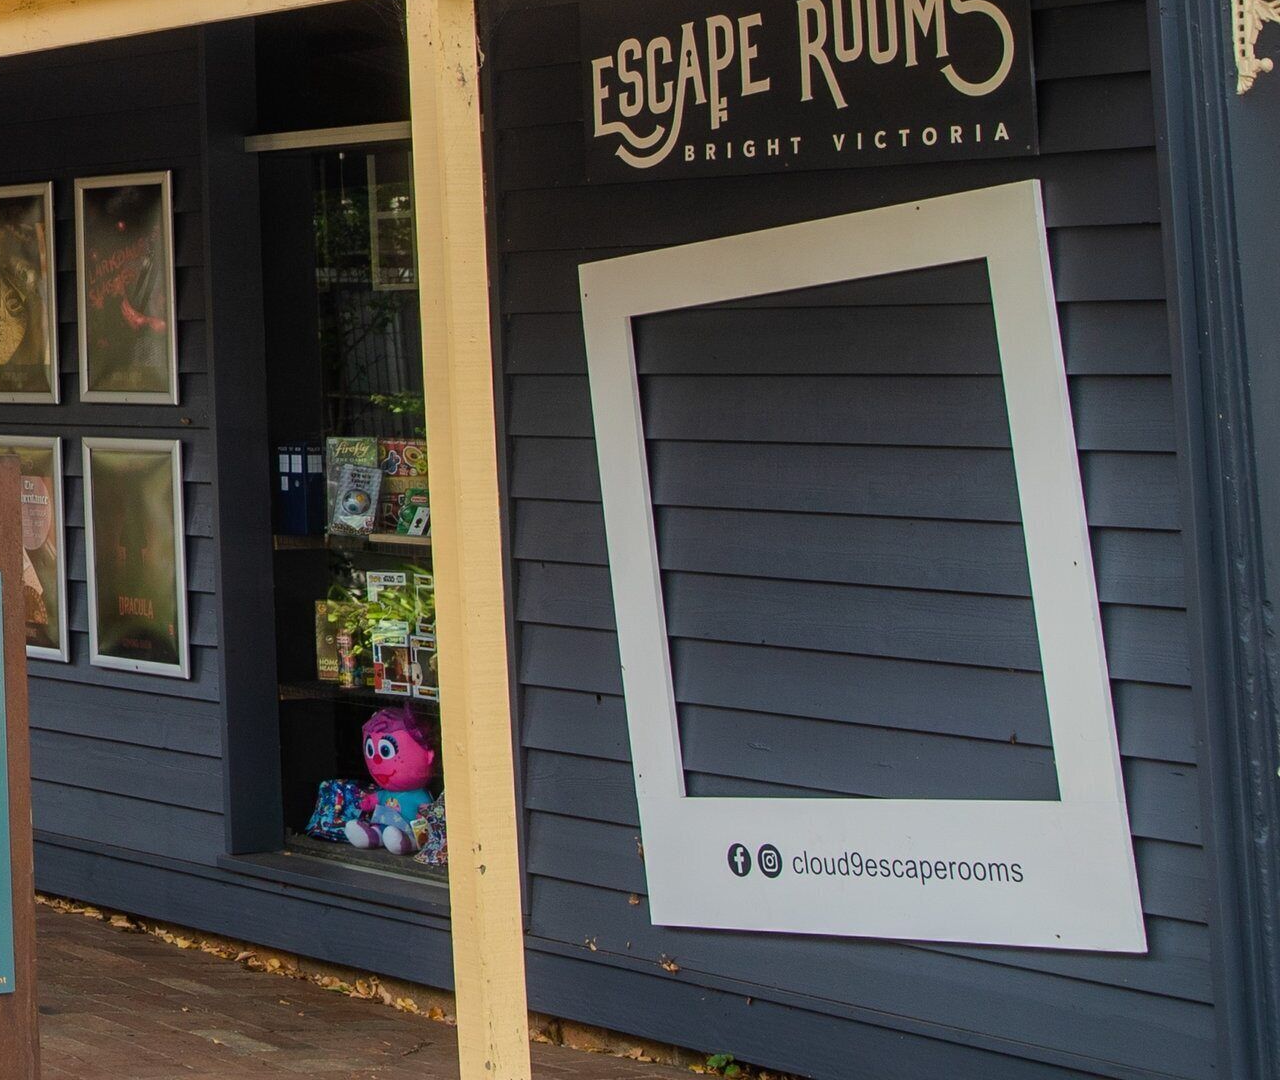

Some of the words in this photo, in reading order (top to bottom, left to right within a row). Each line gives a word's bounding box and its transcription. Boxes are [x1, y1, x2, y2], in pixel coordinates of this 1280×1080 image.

[591, 13, 771, 169] ESCAPE
[684, 136, 803, 163] BRIGHT
[832, 122, 1010, 152] VICTORIA
[118, 595, 154, 619] DRACULA
[792, 850, 1025, 885] cloud9escaperooms
